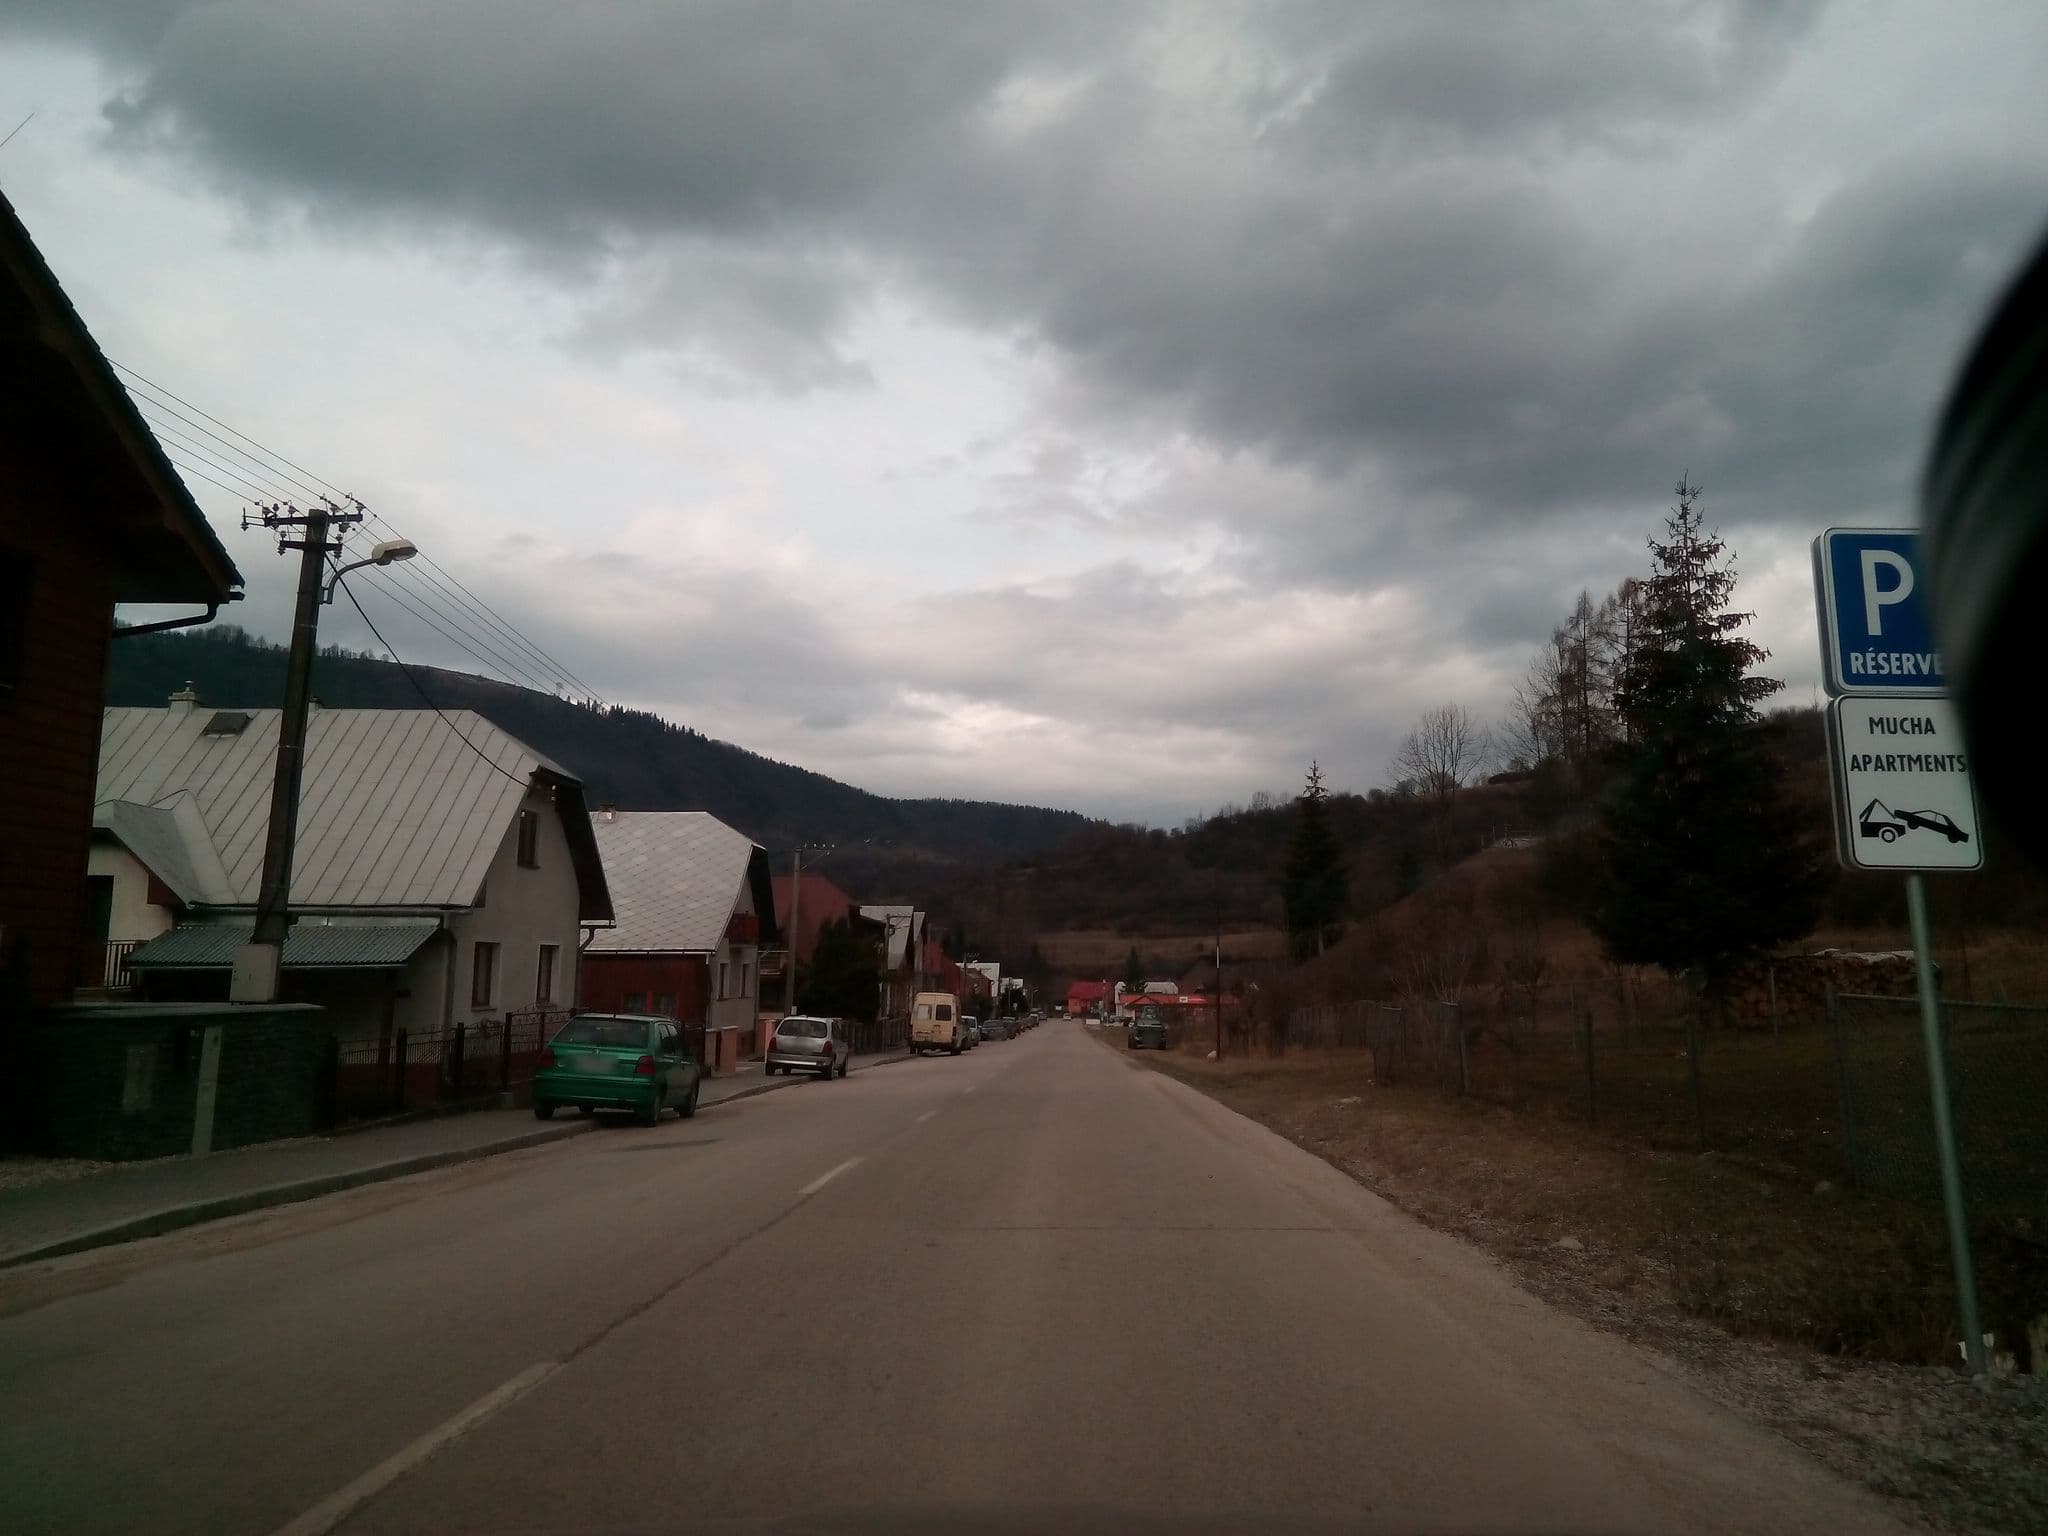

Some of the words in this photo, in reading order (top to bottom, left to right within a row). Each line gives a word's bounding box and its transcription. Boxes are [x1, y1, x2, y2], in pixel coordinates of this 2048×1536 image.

[1860, 549, 1914, 636] P
[1868, 716, 1936, 735] MUCHA
[1850, 754, 1967, 773] APARTMENTS
